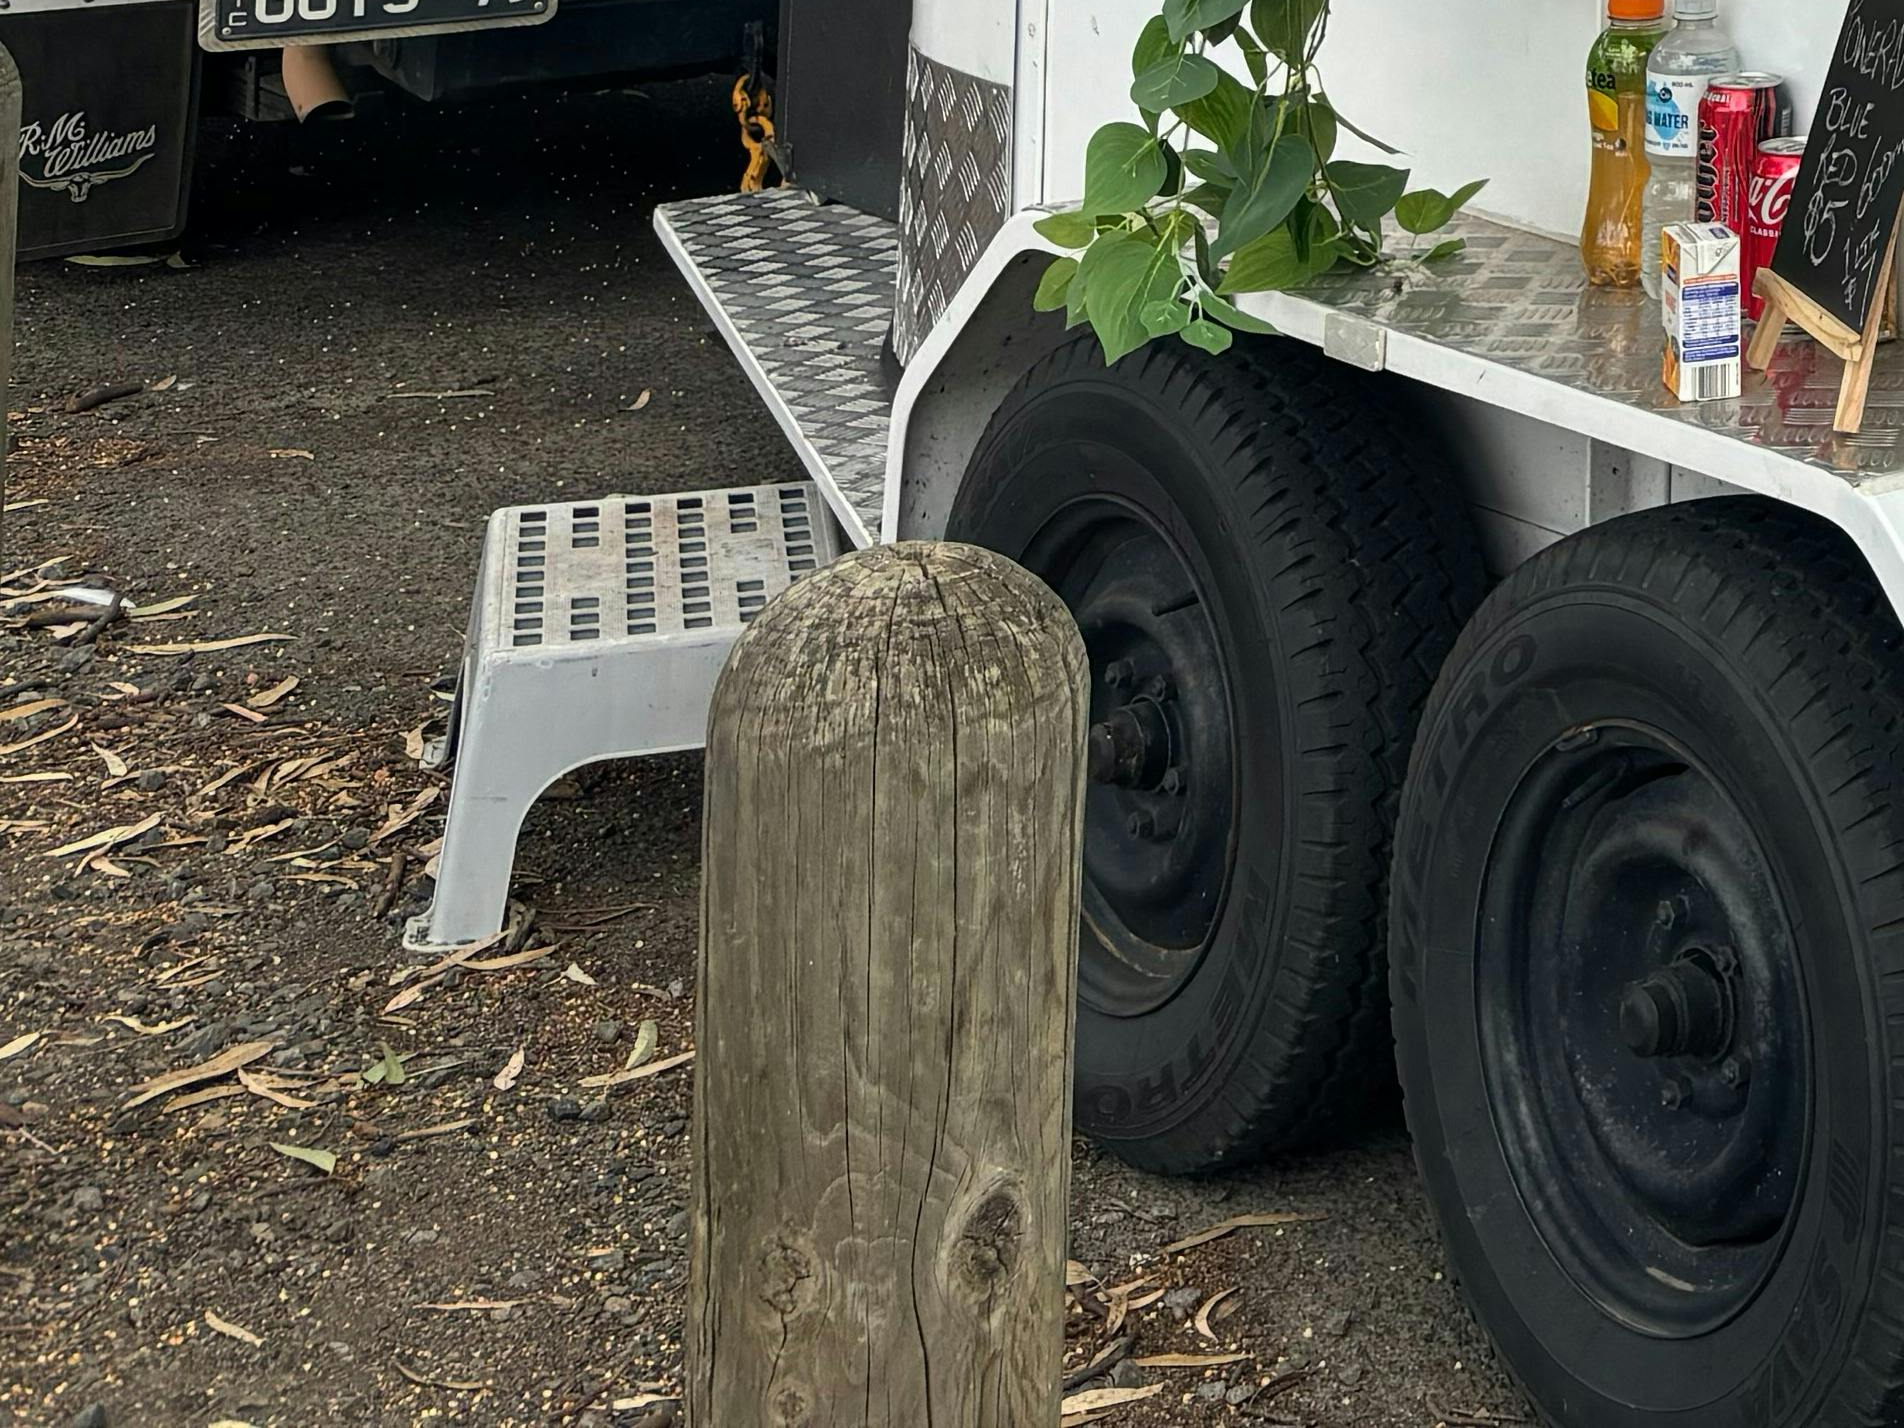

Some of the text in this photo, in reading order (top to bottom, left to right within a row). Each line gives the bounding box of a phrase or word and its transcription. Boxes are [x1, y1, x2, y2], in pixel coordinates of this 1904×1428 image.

[1653, 110, 1690, 130] WATER
[1826, 87, 1876, 140] BLUE
[43, 124, 156, 178] Williams
[1813, 131, 1858, 187] RED
[1803, 180, 1850, 267] $5
